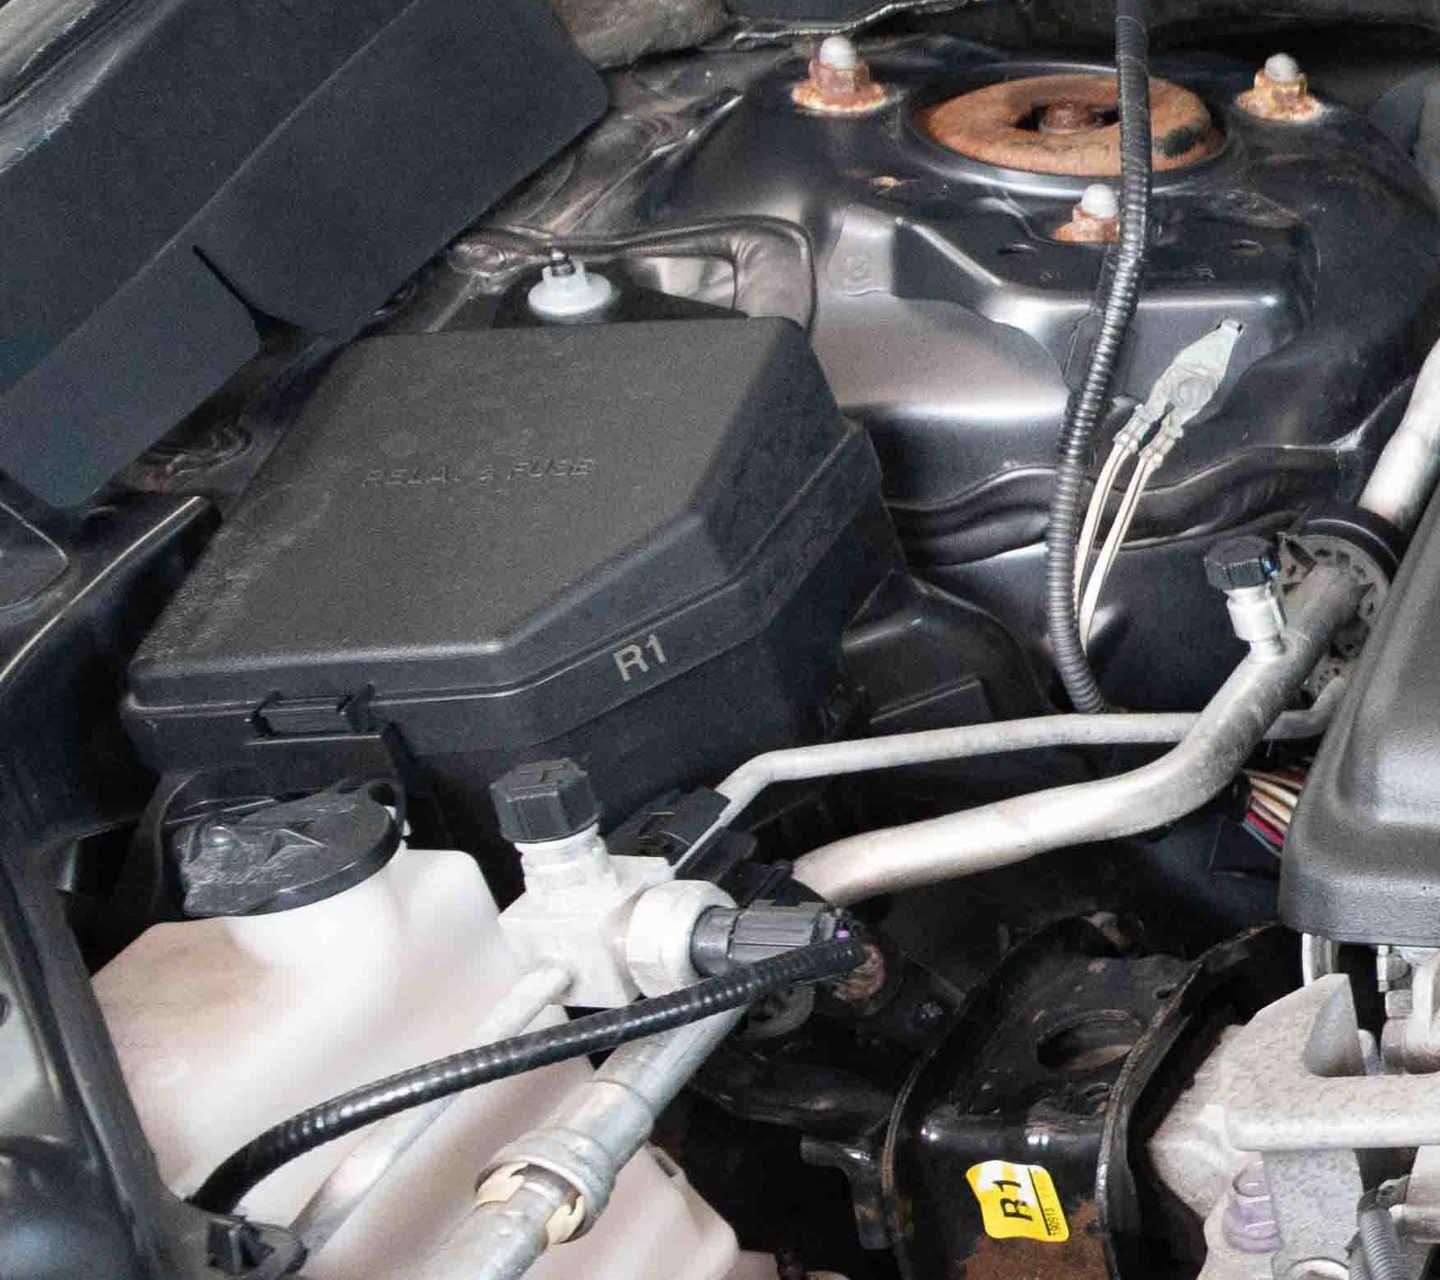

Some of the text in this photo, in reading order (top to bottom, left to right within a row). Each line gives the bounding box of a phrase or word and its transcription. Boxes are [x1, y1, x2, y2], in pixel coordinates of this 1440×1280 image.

[507, 458, 598, 481] FUSE
[613, 633, 665, 682] R1
[993, 1180, 1033, 1221] R1
